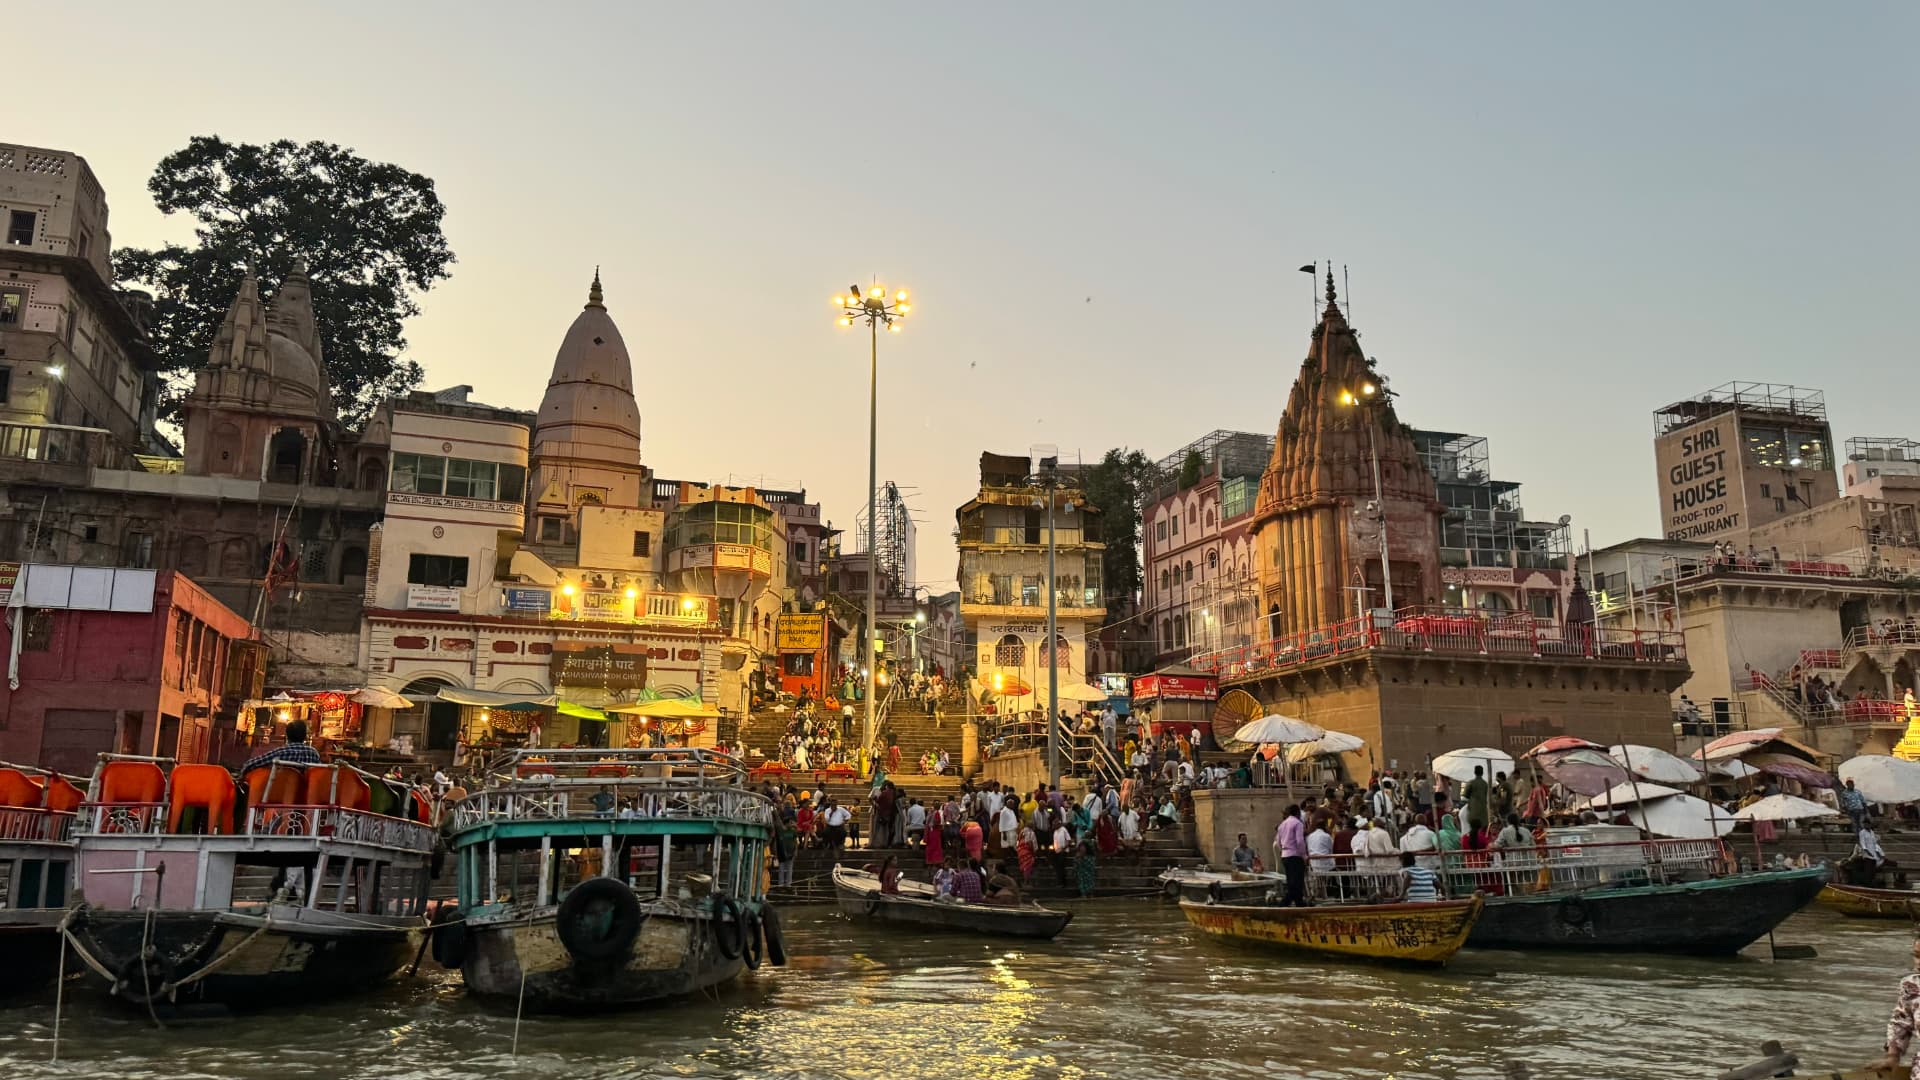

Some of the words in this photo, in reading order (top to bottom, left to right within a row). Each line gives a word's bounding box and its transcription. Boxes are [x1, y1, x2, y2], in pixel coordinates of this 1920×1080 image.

[1682, 427, 1720, 457] SHRI
[1670, 450, 1726, 486] GUEST
[1673, 476, 1727, 512] HOUSE
[1668, 513, 1739, 541] RESTAURANT
[1669, 503, 1727, 527] (ROOF-TOP)
